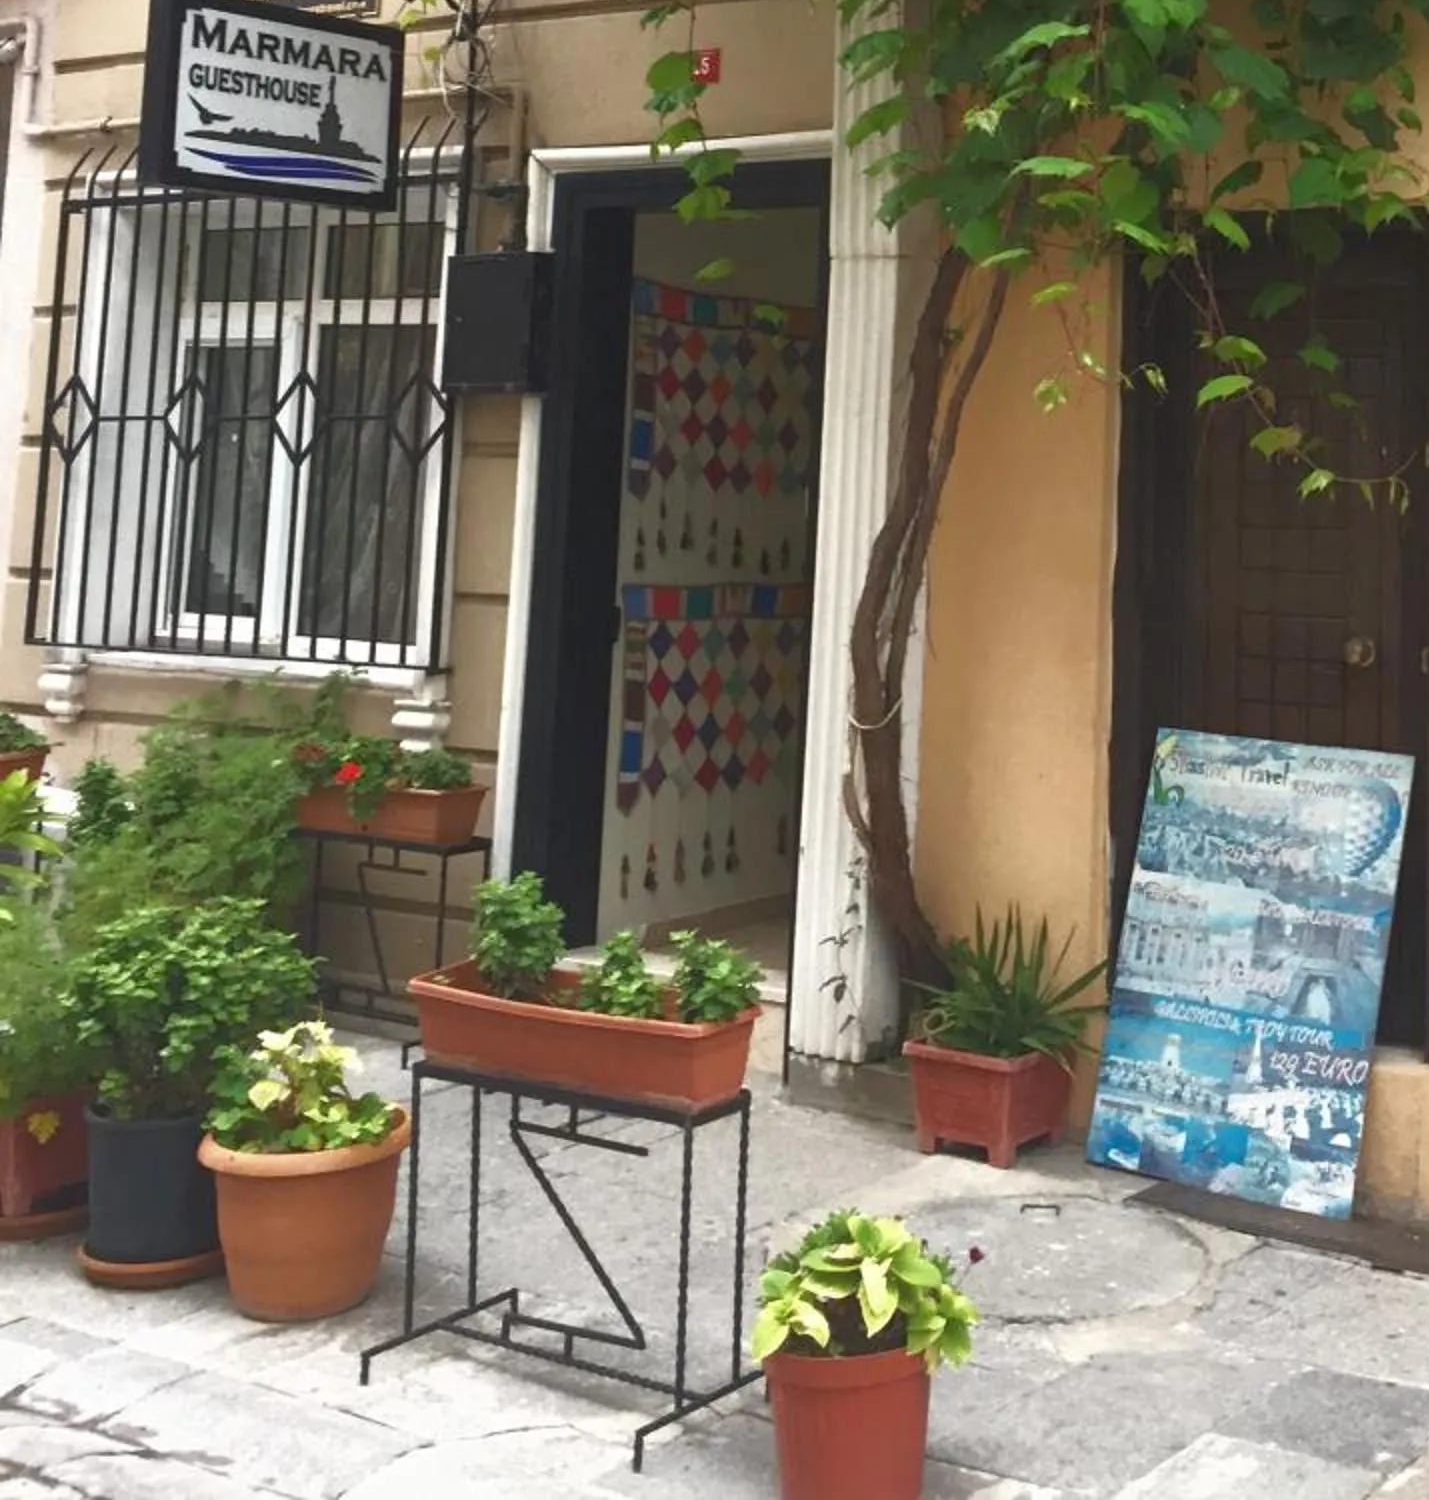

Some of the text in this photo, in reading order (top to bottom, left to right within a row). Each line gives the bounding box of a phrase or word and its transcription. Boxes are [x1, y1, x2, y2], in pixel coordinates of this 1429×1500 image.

[191, 14, 387, 82] MARMARA
[188, 63, 322, 109] GUESTHOUSE
[1301, 1051, 1370, 1087] EURO
